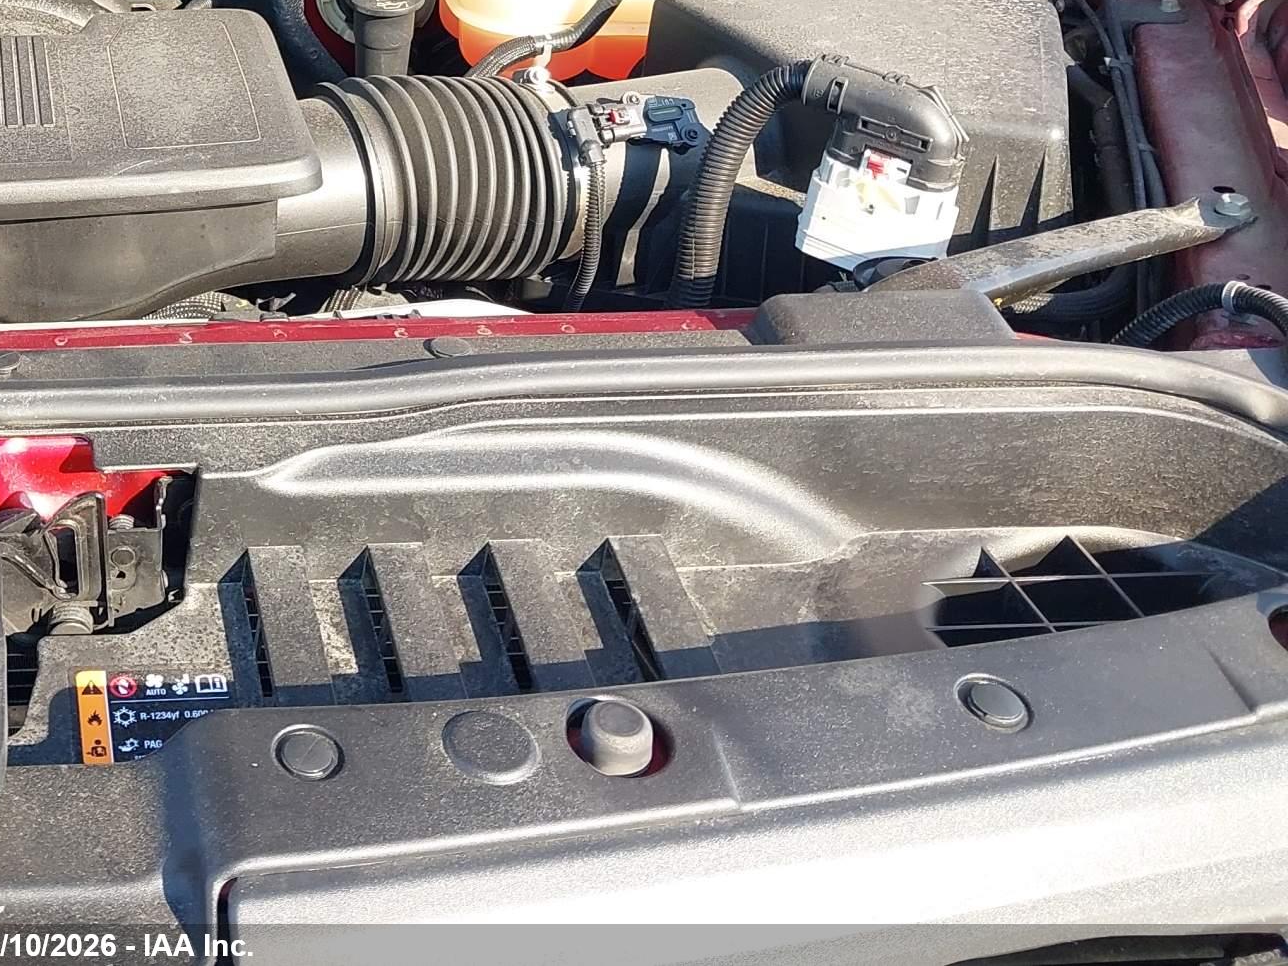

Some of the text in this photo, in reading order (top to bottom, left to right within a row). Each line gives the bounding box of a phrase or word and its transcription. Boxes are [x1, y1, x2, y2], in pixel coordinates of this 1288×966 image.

[146, 688, 167, 696] AUTO
[140, 710, 180, 721] R-1234yf
[144, 740, 163, 749] PAG
